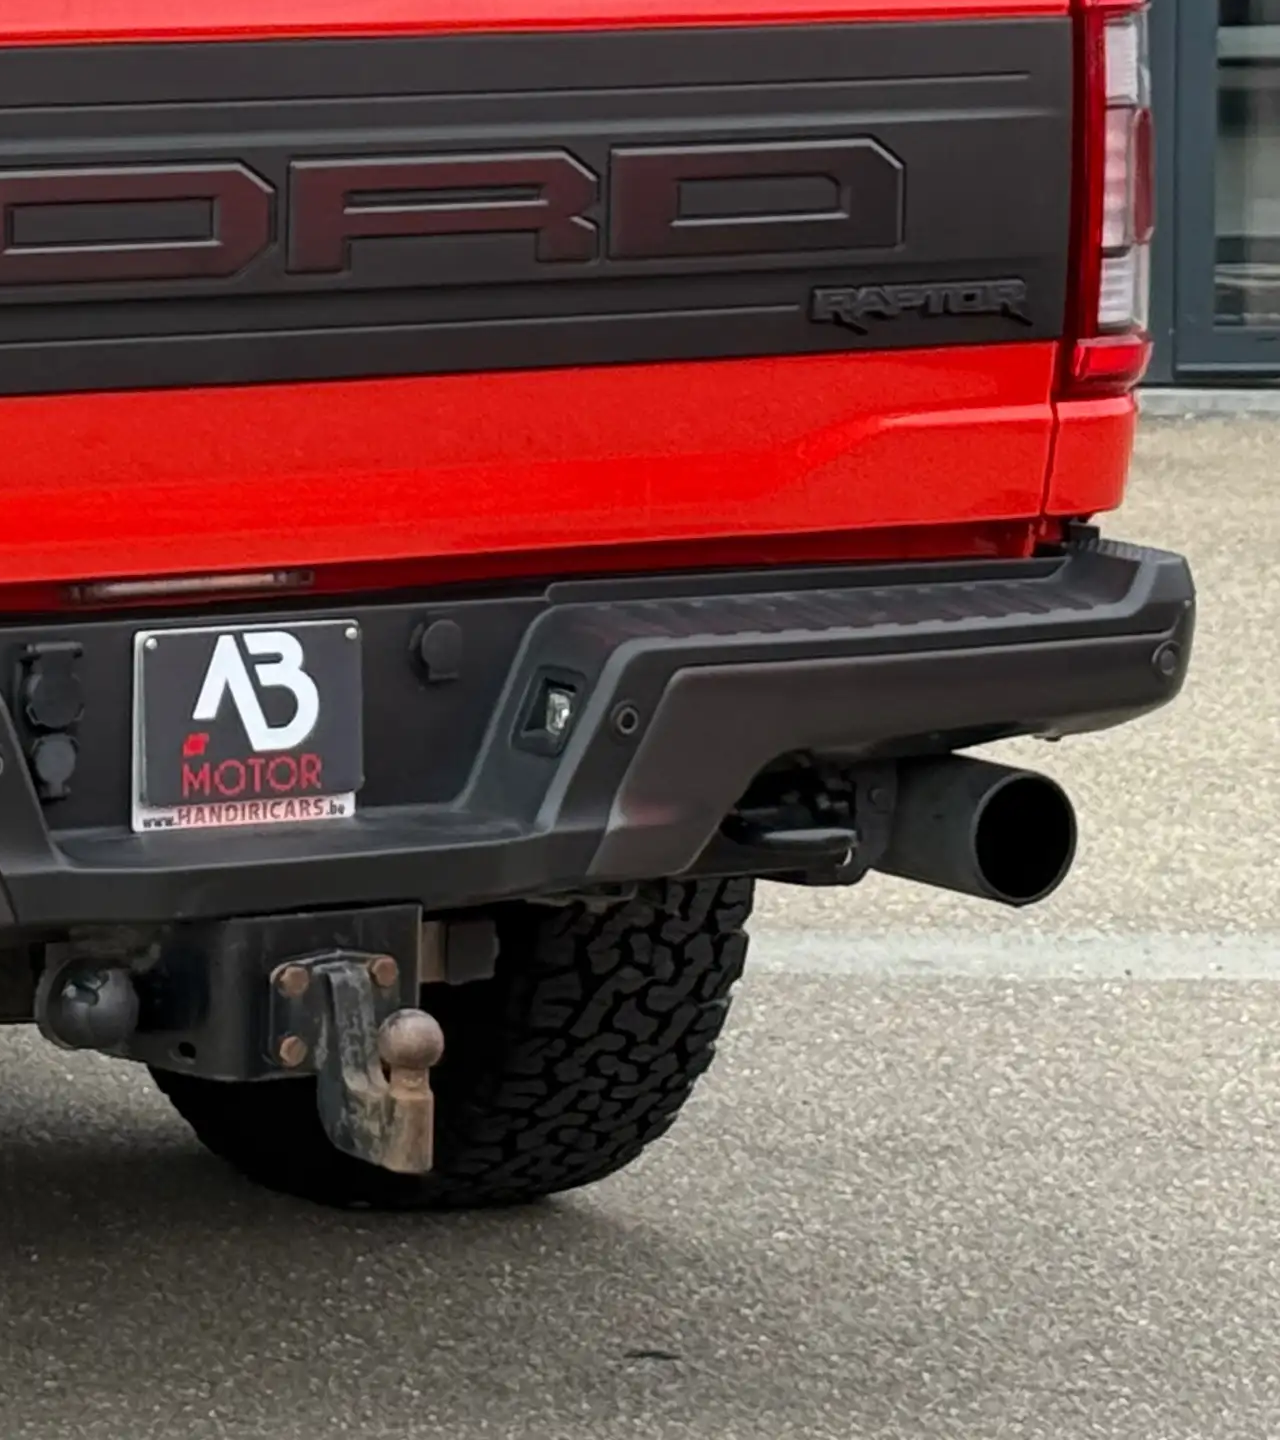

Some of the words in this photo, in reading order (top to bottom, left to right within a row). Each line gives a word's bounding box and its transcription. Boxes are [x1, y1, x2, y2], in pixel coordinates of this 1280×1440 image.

[810, 276, 1033, 336] RAPTOR
[192, 630, 320, 752] AB
[182, 754, 322, 798] MOTOR
